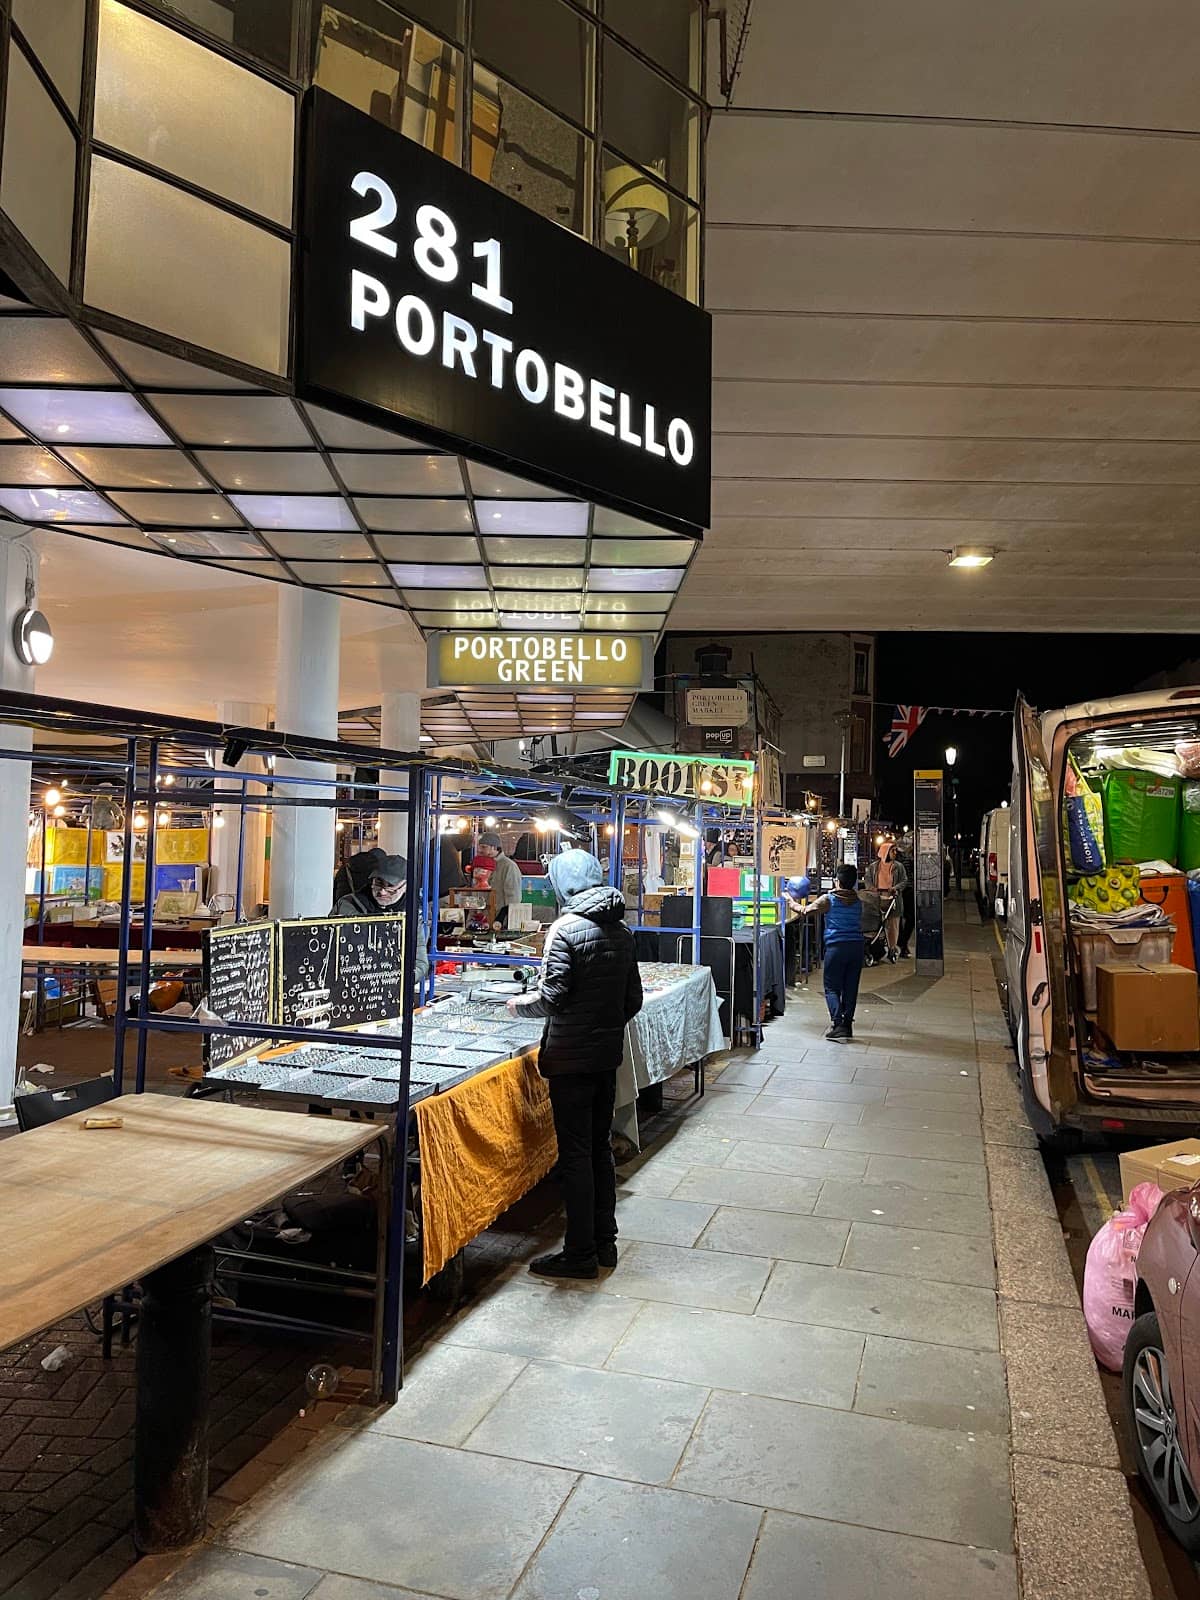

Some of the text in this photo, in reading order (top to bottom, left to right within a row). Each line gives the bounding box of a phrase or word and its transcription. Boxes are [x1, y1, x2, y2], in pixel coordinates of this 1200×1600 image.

[349, 170, 513, 315] 281
[350, 268, 695, 466] PORTOBELLO
[454, 636, 627, 661] PORTOBELLO
[497, 658, 583, 682] GREEN
